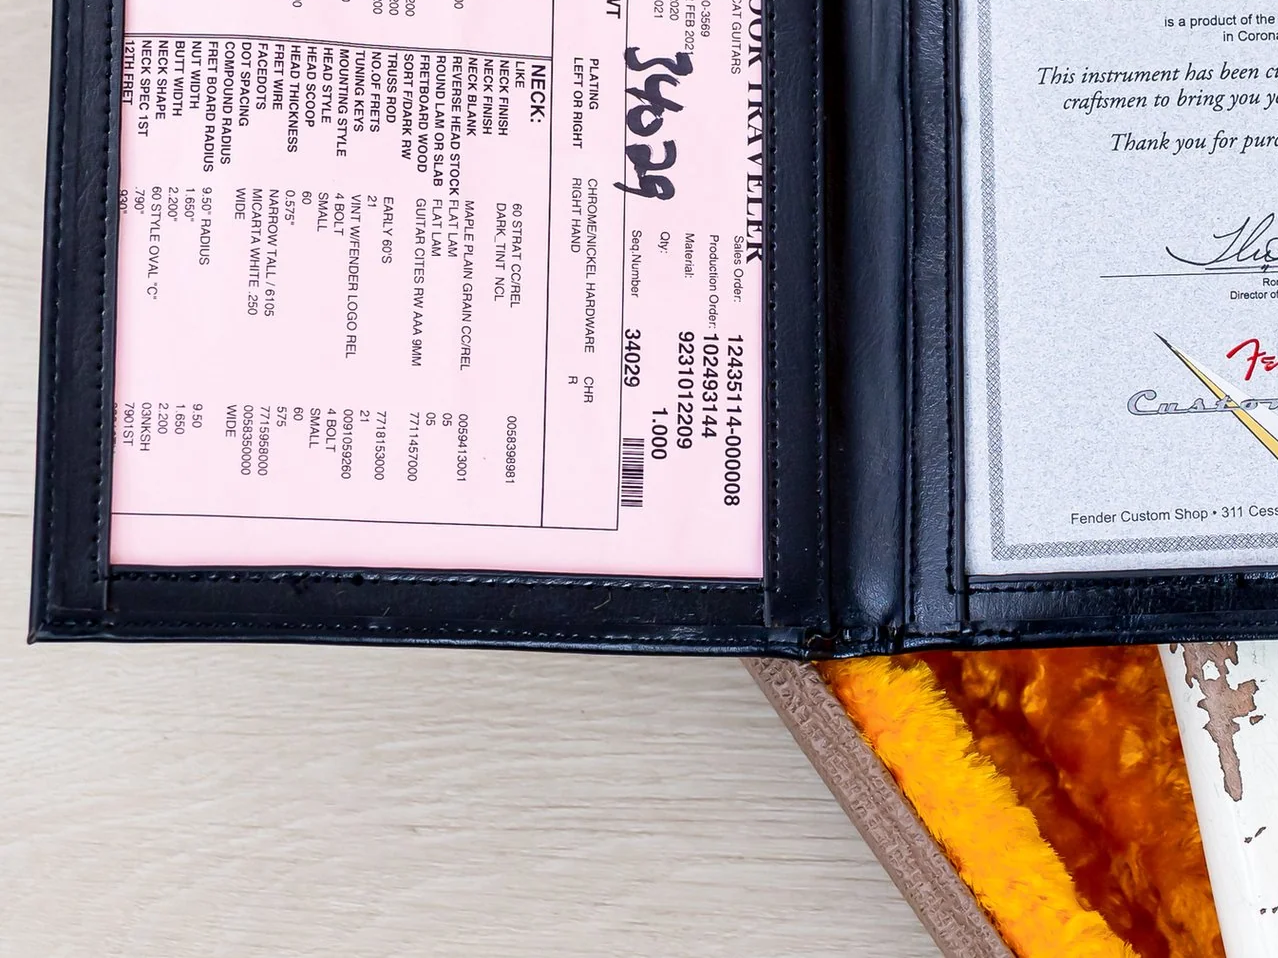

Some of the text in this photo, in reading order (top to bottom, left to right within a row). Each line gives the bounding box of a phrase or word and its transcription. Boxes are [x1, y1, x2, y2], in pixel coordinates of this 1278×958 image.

[1165, 17, 1174, 27] is
[1178, 18, 1186, 27] a
[1190, 15, 1237, 29] product
[1240, 14, 1253, 25] of
[1256, 14, 1275, 24] the
[1223, 31, 1233, 42] in
[731, 22, 742, 74] GUITARS
[1038, 66, 1075, 85] This
[1081, 67, 1180, 83] instrument
[1185, 62, 1214, 81] has
[1220, 61, 1259, 80] been
[530, 65, 546, 122] NECK:
[589, 58, 599, 110] PLATING
[1063, 90, 1148, 115] craftsmen
[1154, 94, 1170, 107] to
[1177, 88, 1225, 112] bring
[1227, 93, 1260, 111] you
[417, 55, 430, 172] FRETBOARD WOOD
[613, 46, 694, 201] 34029
[1111, 131, 1170, 151] Thank
[1172, 137, 1206, 155] you
[1208, 128, 1238, 153] for
[585, 179, 598, 353] CHROME/NICKEL HARDWARE
[630, 230, 642, 298] Seq.Number
[658, 232, 670, 253] Qty:
[685, 233, 695, 278] Material:
[709, 235, 719, 329] Production Order:
[734, 236, 744, 302] Sales Order:
[1230, 291, 1268, 299] Director
[624, 329, 641, 387] 34029
[676, 331, 695, 449] 9231012209
[701, 333, 719, 438] 102493144
[651, 408, 668, 459] 1.000
[724, 335, 743, 506] 12435114-000008
[1071, 512, 1116, 524] Fender
[1121, 510, 1170, 522] Custom
[1175, 508, 1208, 521] Shop
[1222, 506, 1242, 518] 311
